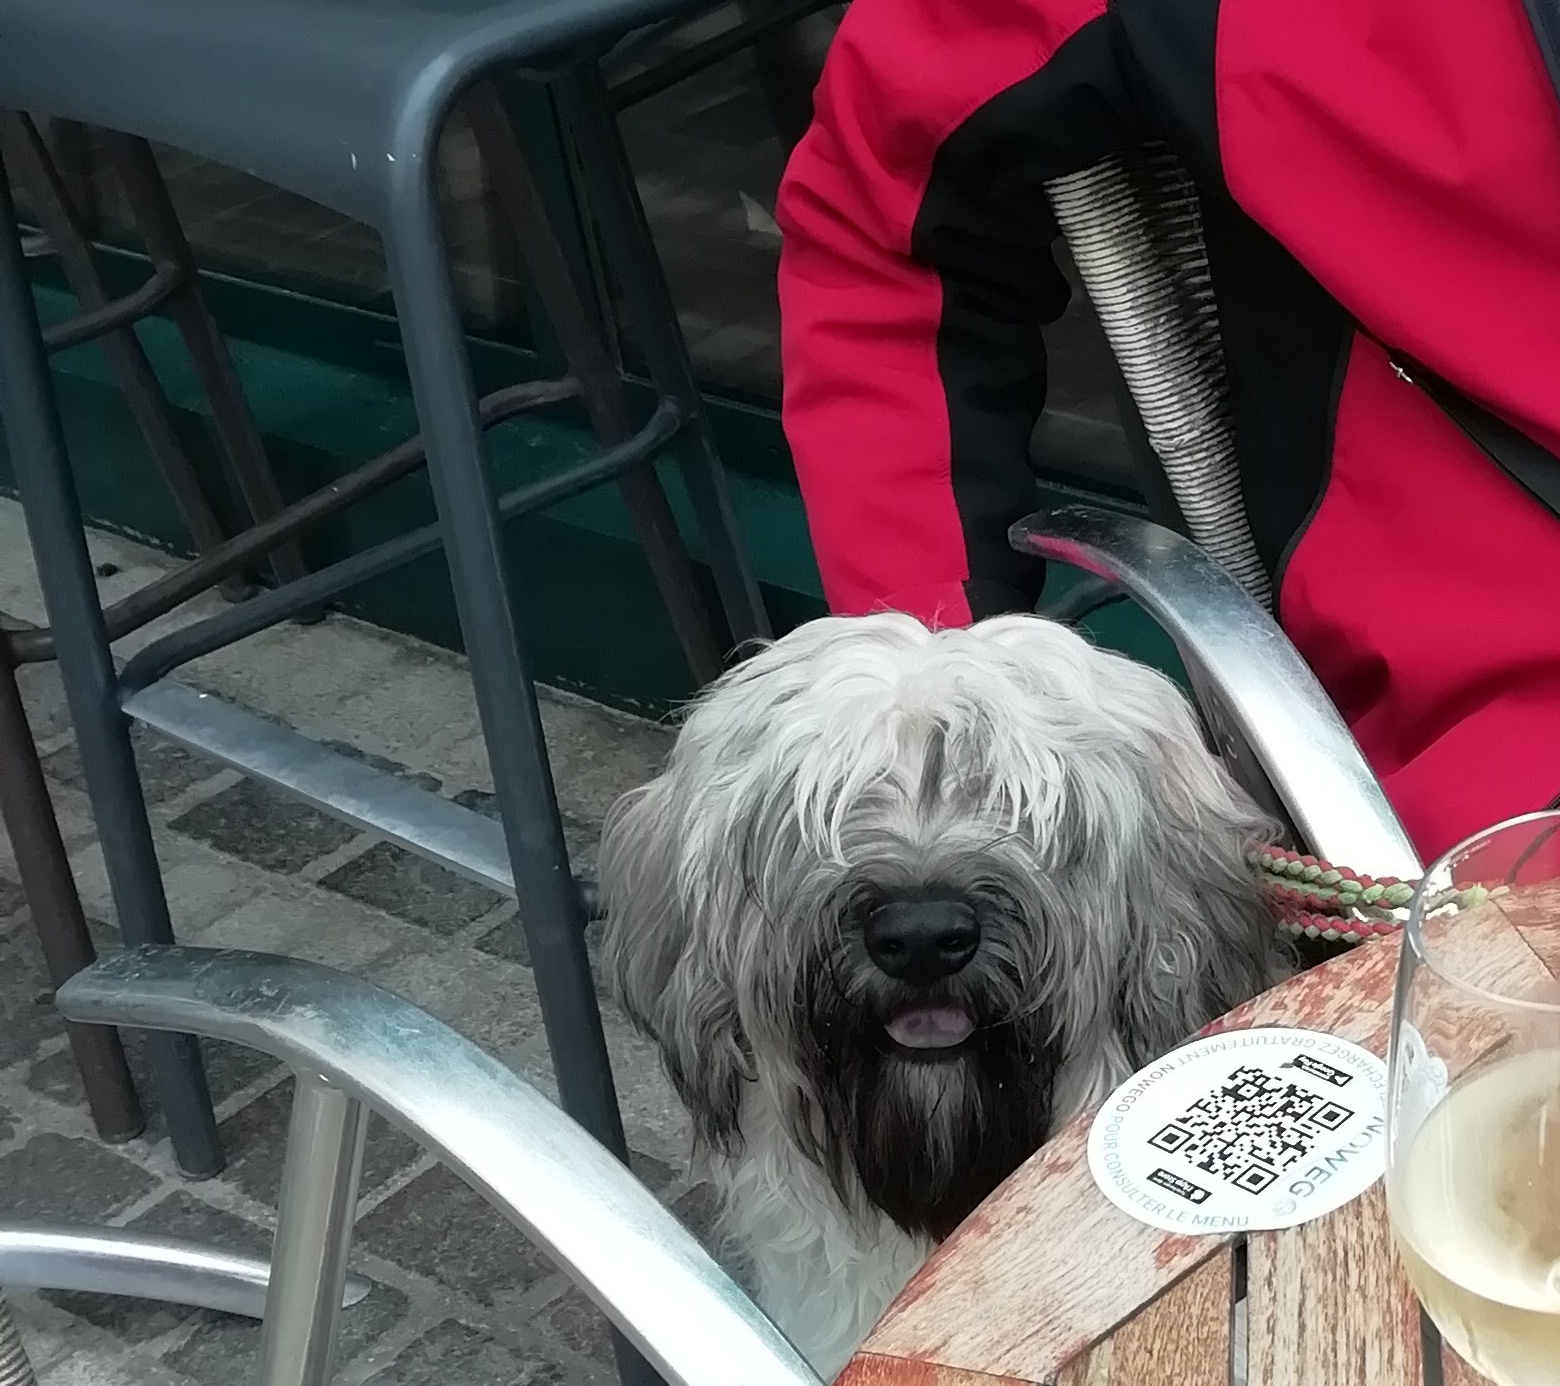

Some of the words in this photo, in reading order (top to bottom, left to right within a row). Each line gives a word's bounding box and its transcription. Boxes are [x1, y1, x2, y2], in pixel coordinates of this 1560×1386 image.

[1177, 1035, 1316, 1066] GRATUITEMENT
[1116, 1063, 1176, 1112] NOWEGO
[1104, 1115, 1124, 1150] POUR
[1104, 1152, 1167, 1215] CONSULTER
[1166, 1208, 1190, 1223] LE
[1192, 1214, 1249, 1227] MENU
